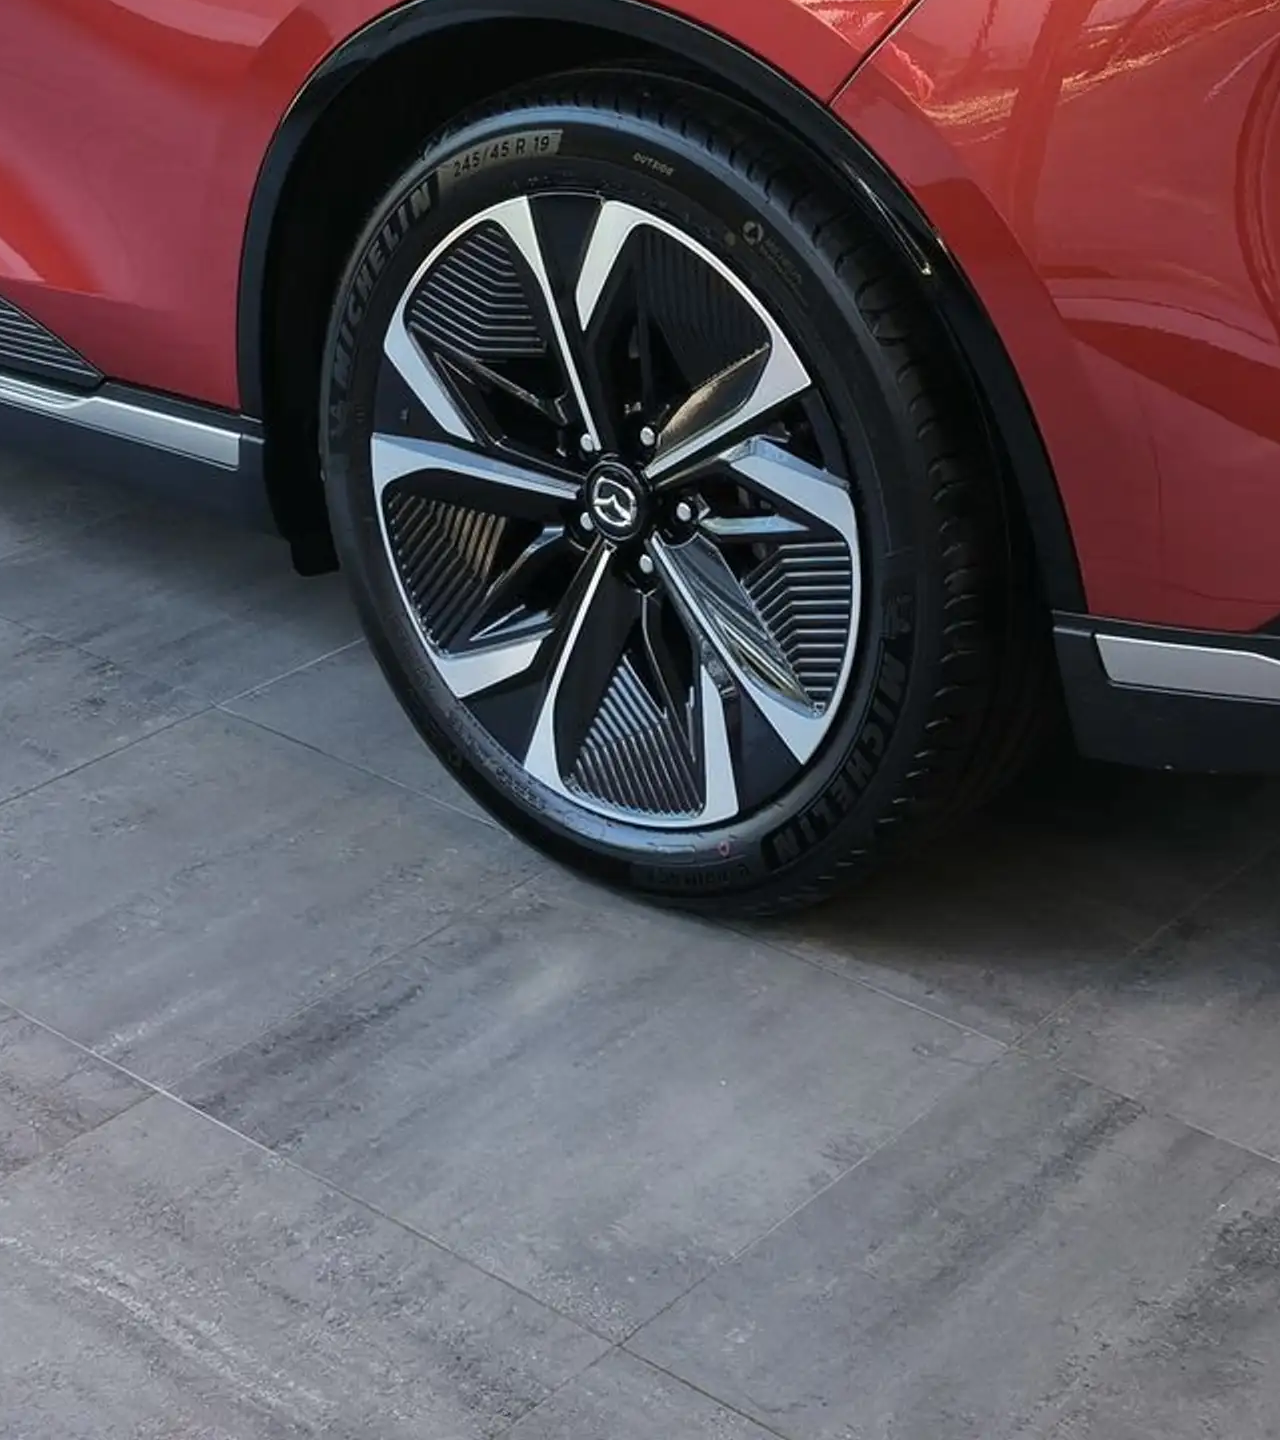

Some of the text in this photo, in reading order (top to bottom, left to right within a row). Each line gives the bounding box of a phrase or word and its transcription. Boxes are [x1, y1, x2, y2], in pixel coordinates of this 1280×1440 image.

[453, 135, 550, 178] 245/45 R 19
[333, 181, 433, 390] MICHELIN
[770, 653, 907, 865] MICHELIN
